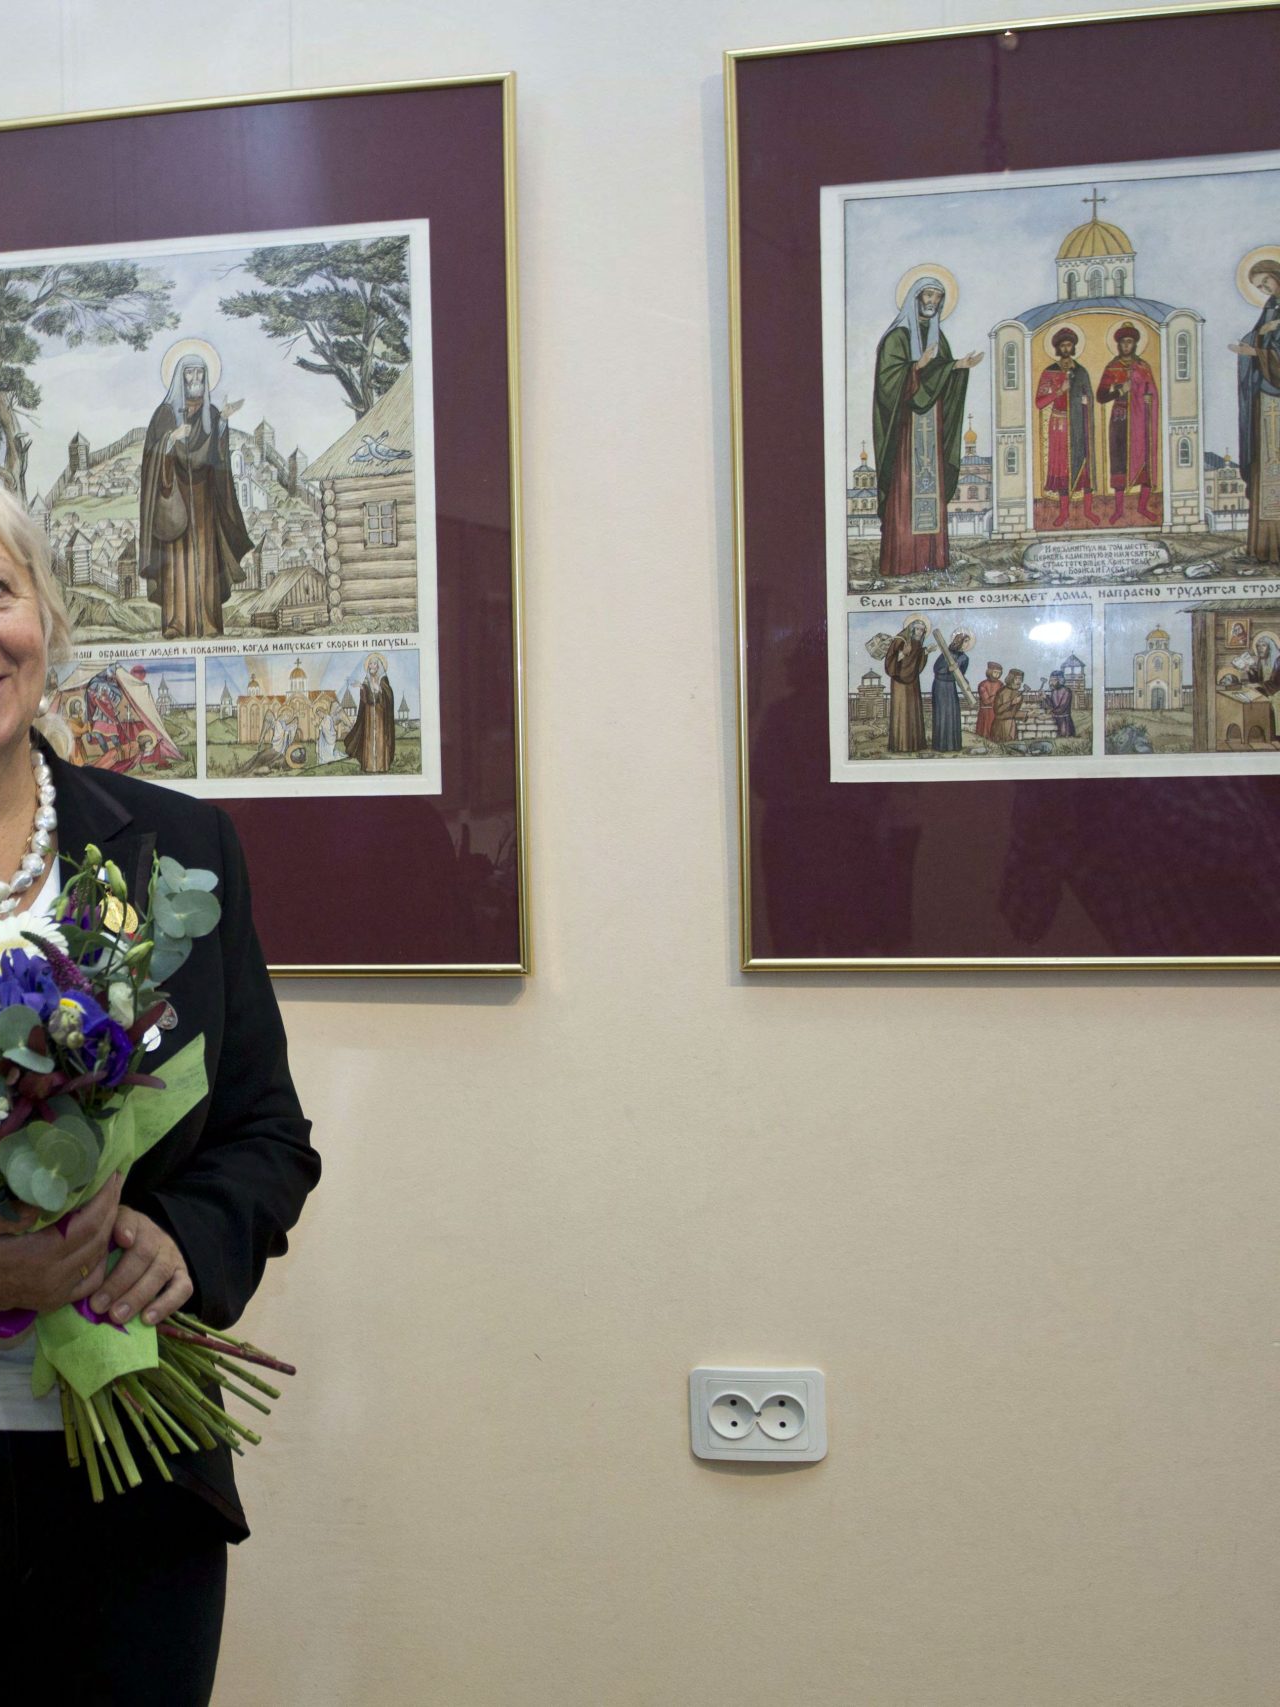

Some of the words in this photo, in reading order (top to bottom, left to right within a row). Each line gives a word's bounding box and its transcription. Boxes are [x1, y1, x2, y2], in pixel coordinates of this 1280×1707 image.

[898, 595, 952, 606] Господь
[958, 595, 974, 604] не
[980, 592, 1047, 604] созиждет
[1052, 590, 1092, 602] дома,
[1098, 587, 1160, 601] напрасно
[1166, 585, 1236, 599] трудятся
